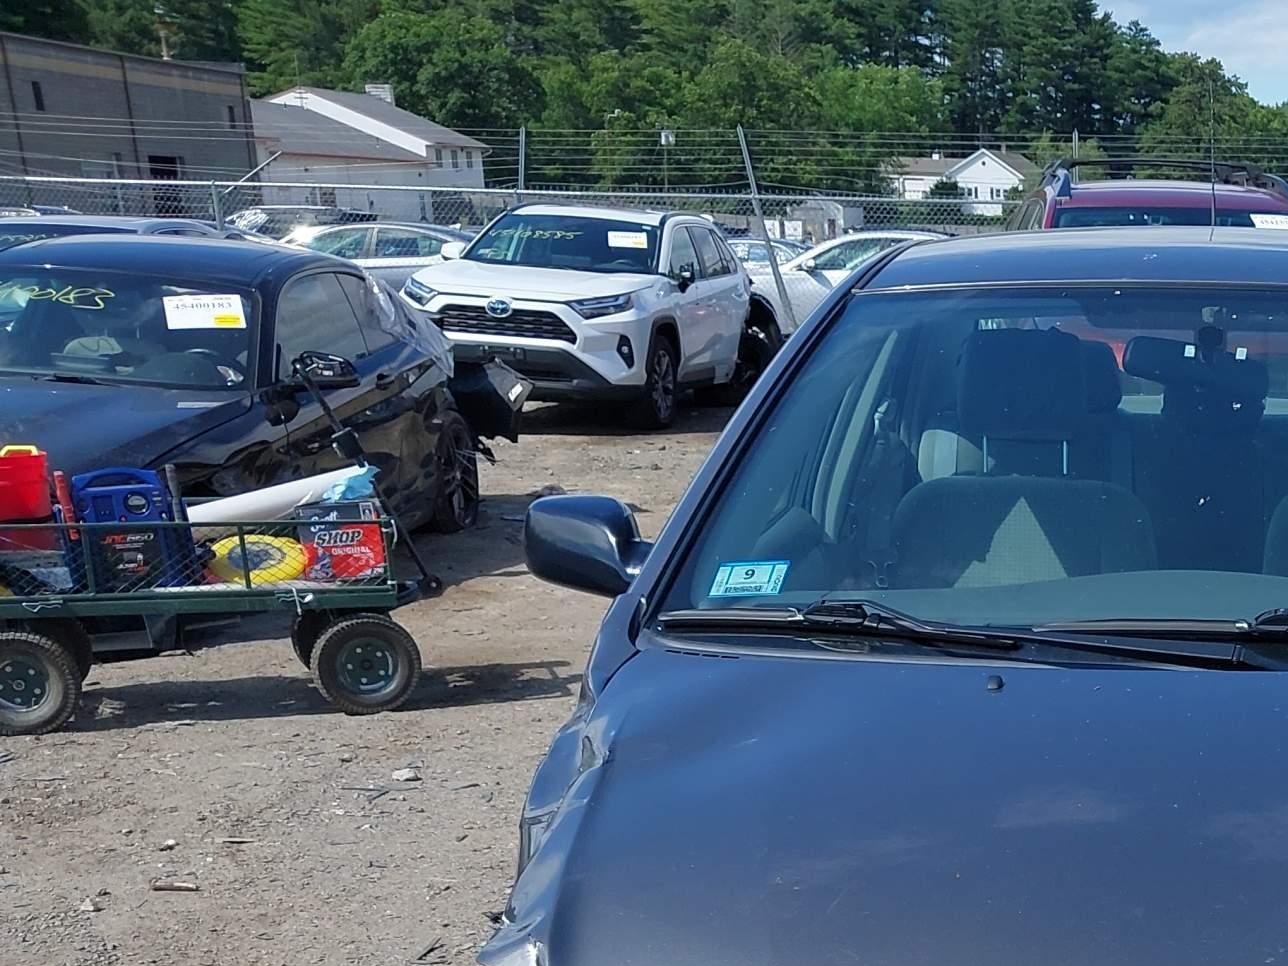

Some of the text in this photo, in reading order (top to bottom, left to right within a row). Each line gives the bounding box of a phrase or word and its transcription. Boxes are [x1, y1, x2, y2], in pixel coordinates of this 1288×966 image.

[315, 530, 362, 546] SHOP
[331, 546, 370, 555] ORIGINAL
[743, 569, 756, 580] 9
